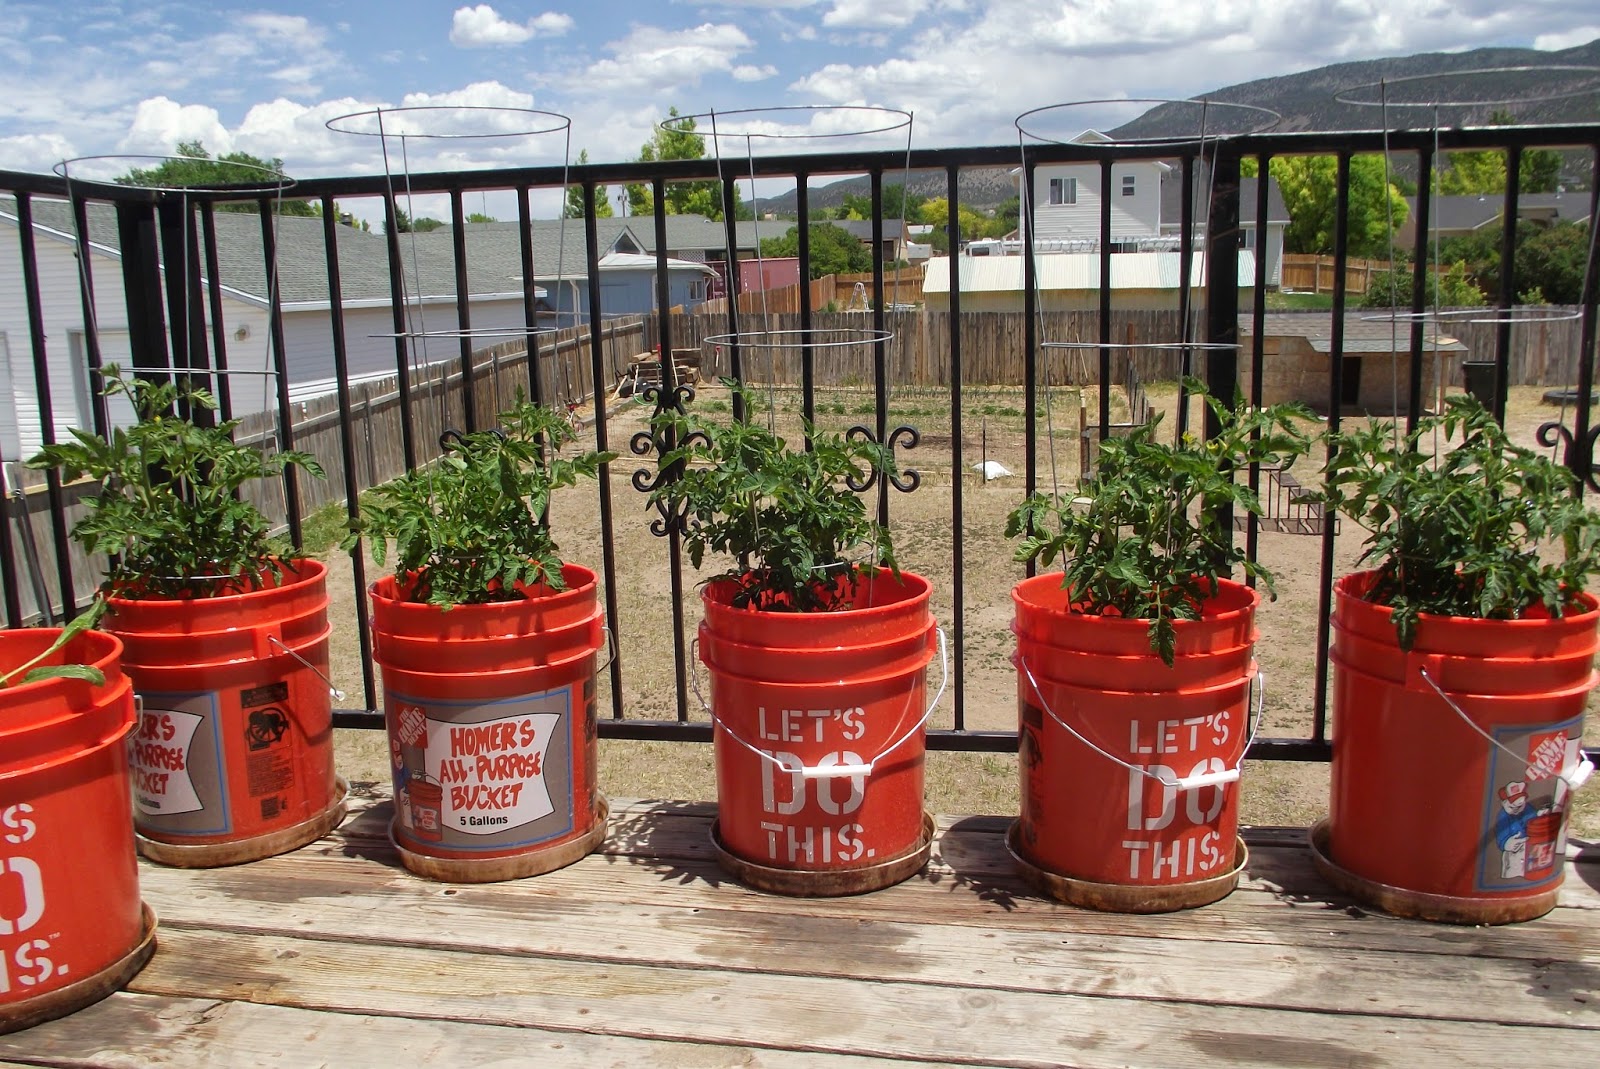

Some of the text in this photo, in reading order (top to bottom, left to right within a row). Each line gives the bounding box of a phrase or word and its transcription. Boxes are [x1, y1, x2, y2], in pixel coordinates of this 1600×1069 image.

[398, 707, 426, 744] HOME
[450, 719, 536, 758] HOMER'S
[759, 707, 865, 743] LET'S
[1130, 711, 1230, 754] LET'S
[450, 782, 523, 811] BUCKET
[761, 750, 865, 815] DO
[1128, 757, 1226, 831] DO
[460, 815, 508, 826] 5 Gallons
[761, 821, 875, 863] THIS.
[1122, 831, 1225, 879] THIS.
